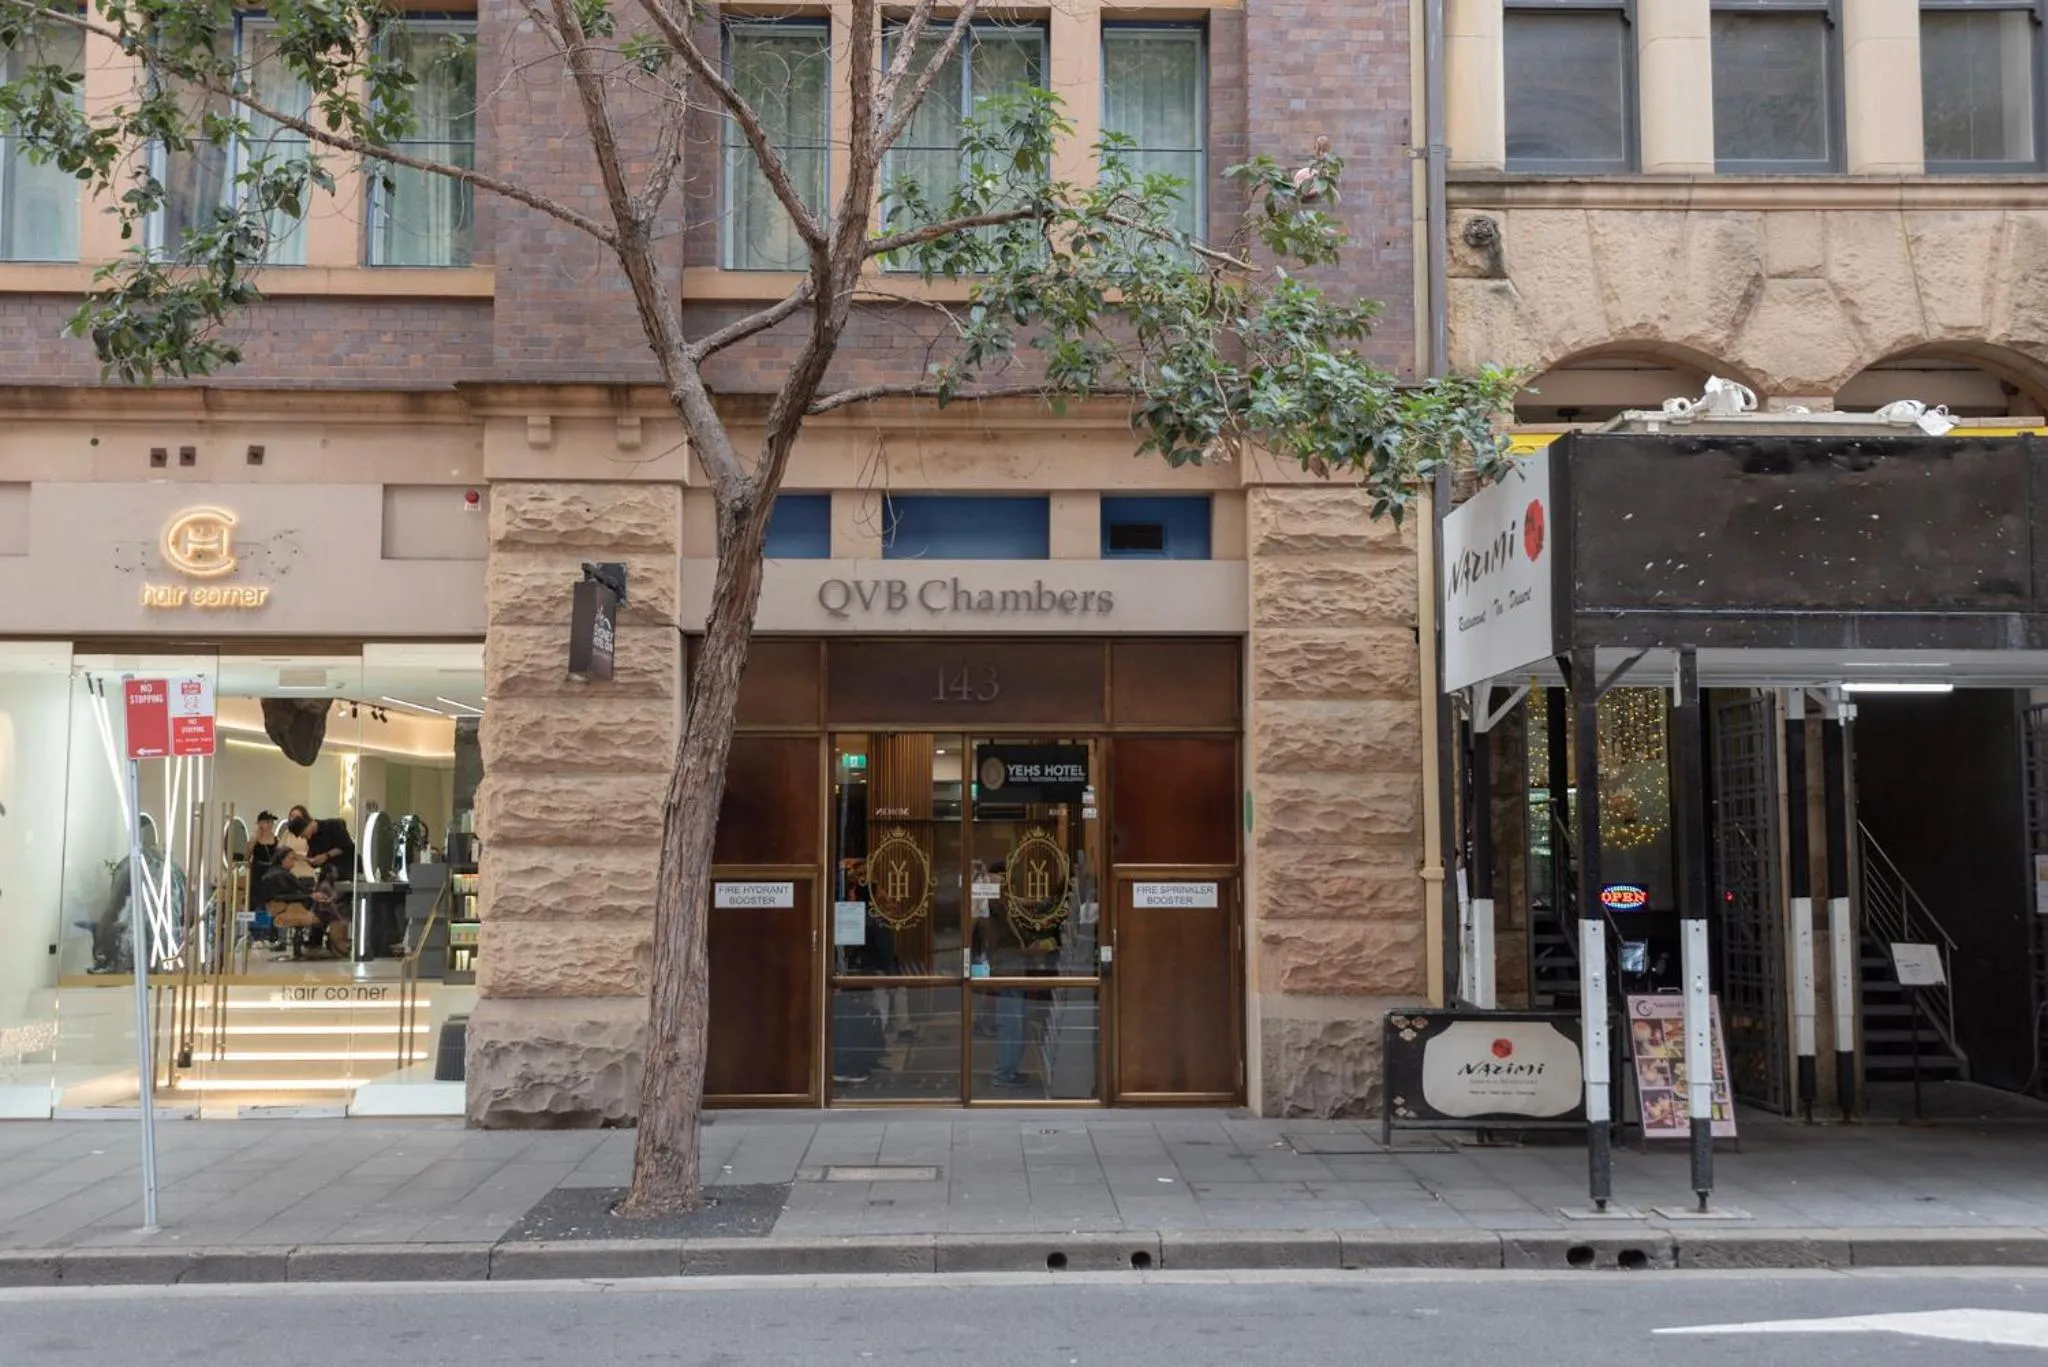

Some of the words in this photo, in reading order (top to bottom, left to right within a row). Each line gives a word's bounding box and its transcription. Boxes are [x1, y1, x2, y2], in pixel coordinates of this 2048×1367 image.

[142, 582, 189, 607] hair
[190, 585, 269, 607] corner
[818, 579, 908, 617] QVB
[917, 577, 1115, 613] Chambers
[140, 684, 153, 693] NO
[932, 666, 1000, 703] 143
[130, 694, 164, 704] STOPPING
[1007, 764, 1041, 776] YEHS
[1045, 764, 1086, 776] HOTEL
[719, 885, 740, 894] FIRE
[744, 885, 788, 894] HYDRANT
[1136, 885, 1157, 894] FIRE
[1160, 885, 1213, 895] SPRINKLER
[729, 896, 776, 905] BOOSTER
[1147, 896, 1193, 905] BOOSTER
[1600, 891, 1647, 903] OPEN
